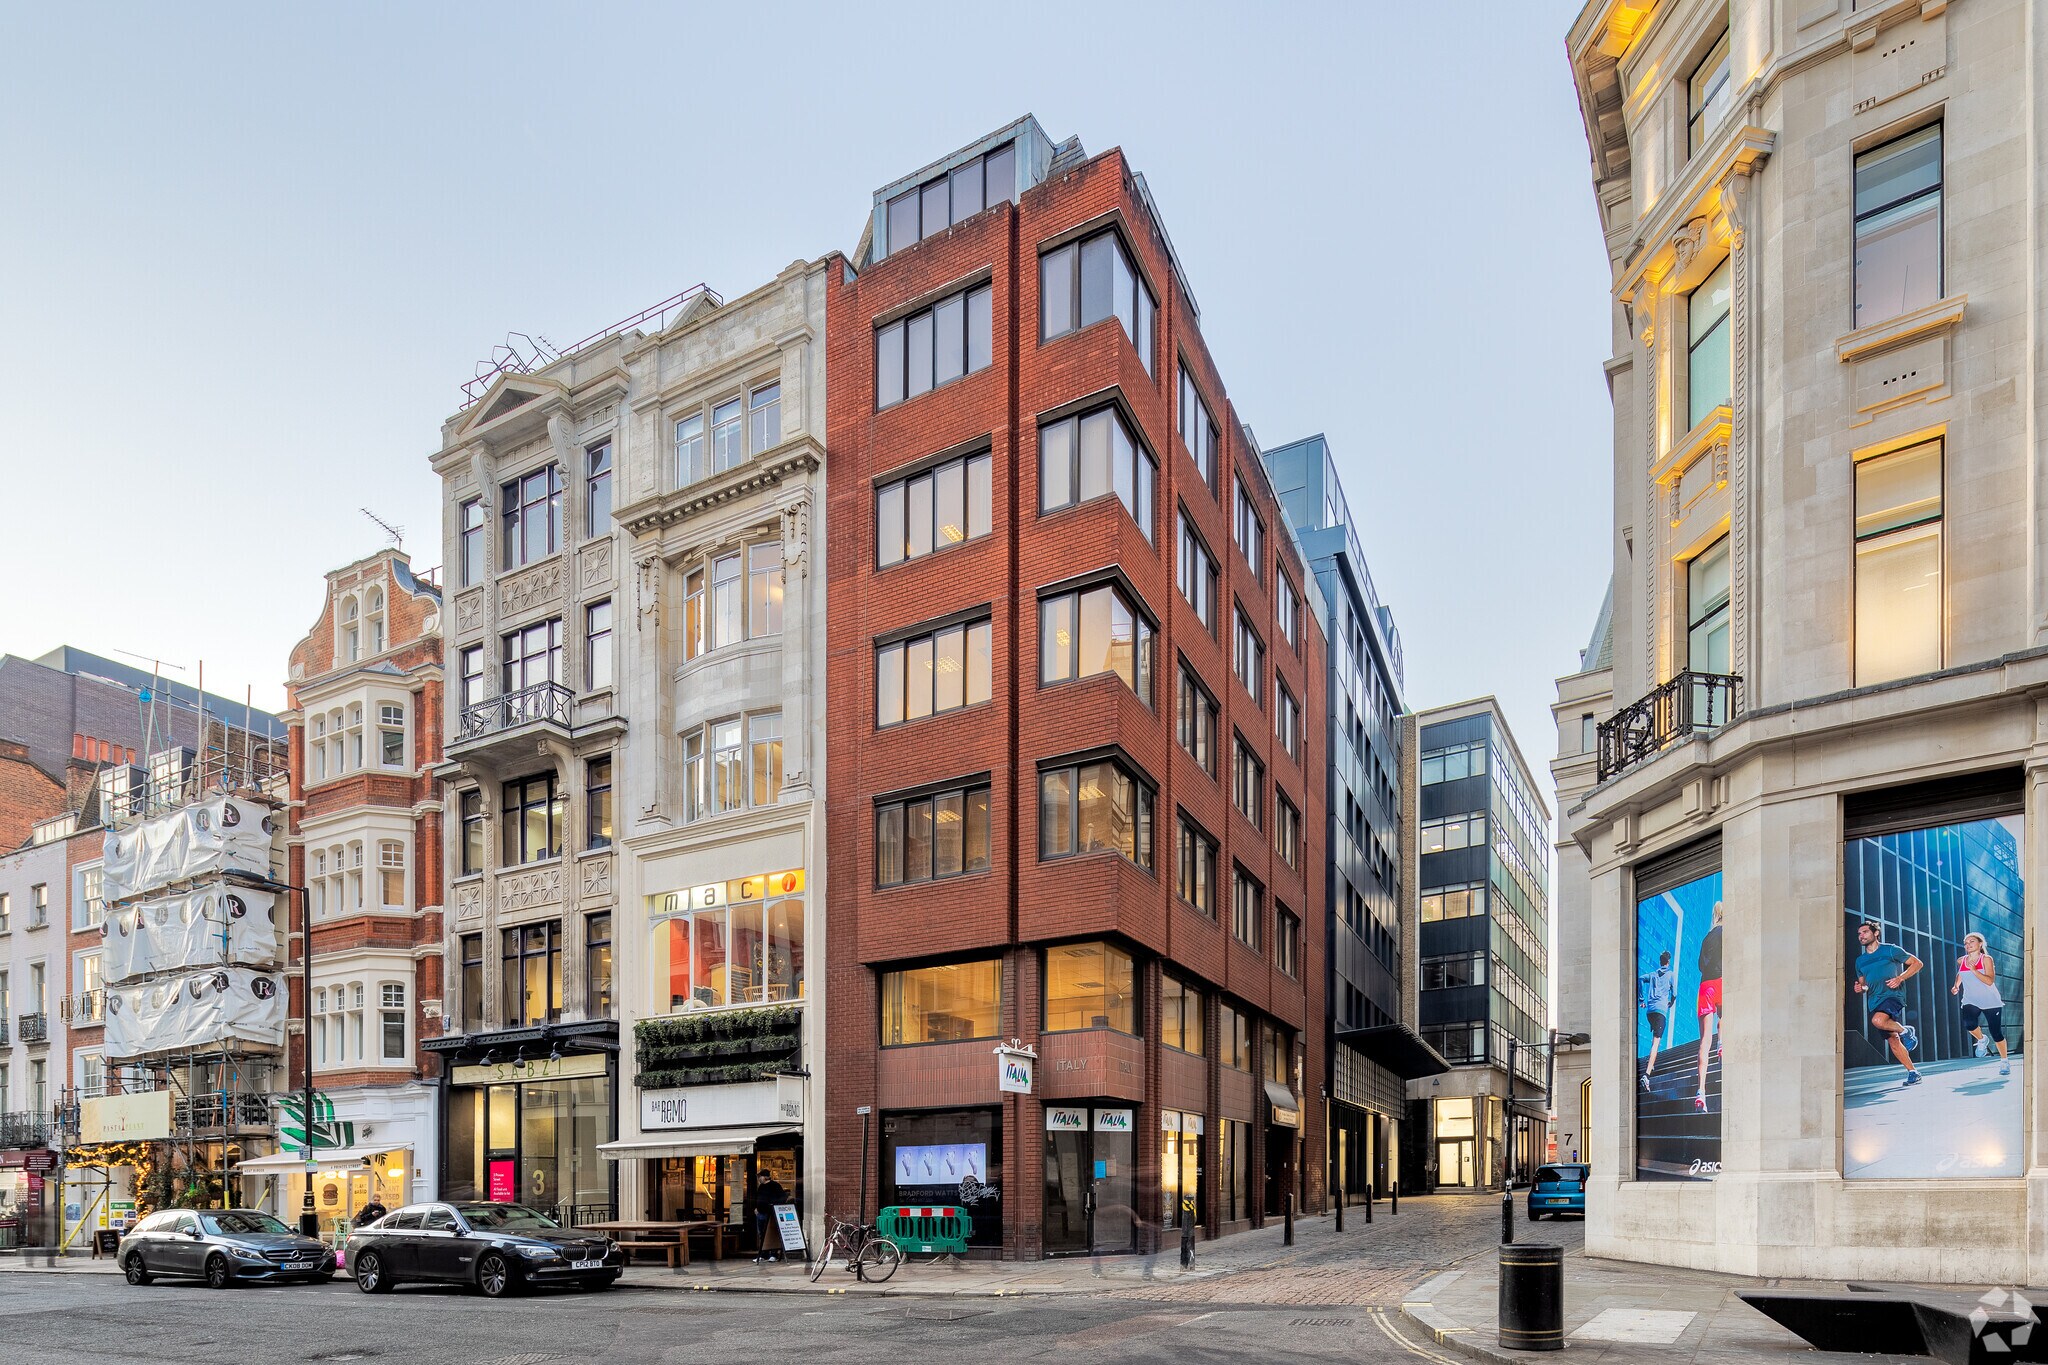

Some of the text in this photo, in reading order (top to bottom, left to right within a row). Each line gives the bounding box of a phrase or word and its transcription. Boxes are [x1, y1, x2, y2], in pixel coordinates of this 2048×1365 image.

[497, 1060, 562, 1080] SABZI
[1006, 1060, 1029, 1087] ITALIA
[1056, 1060, 1087, 1072] ITALY
[1053, 1110, 1082, 1128] ITALIA
[1099, 1111, 1127, 1129] ITALIA
[1564, 1133, 1573, 1146] 7
[532, 1169, 545, 1196] 3
